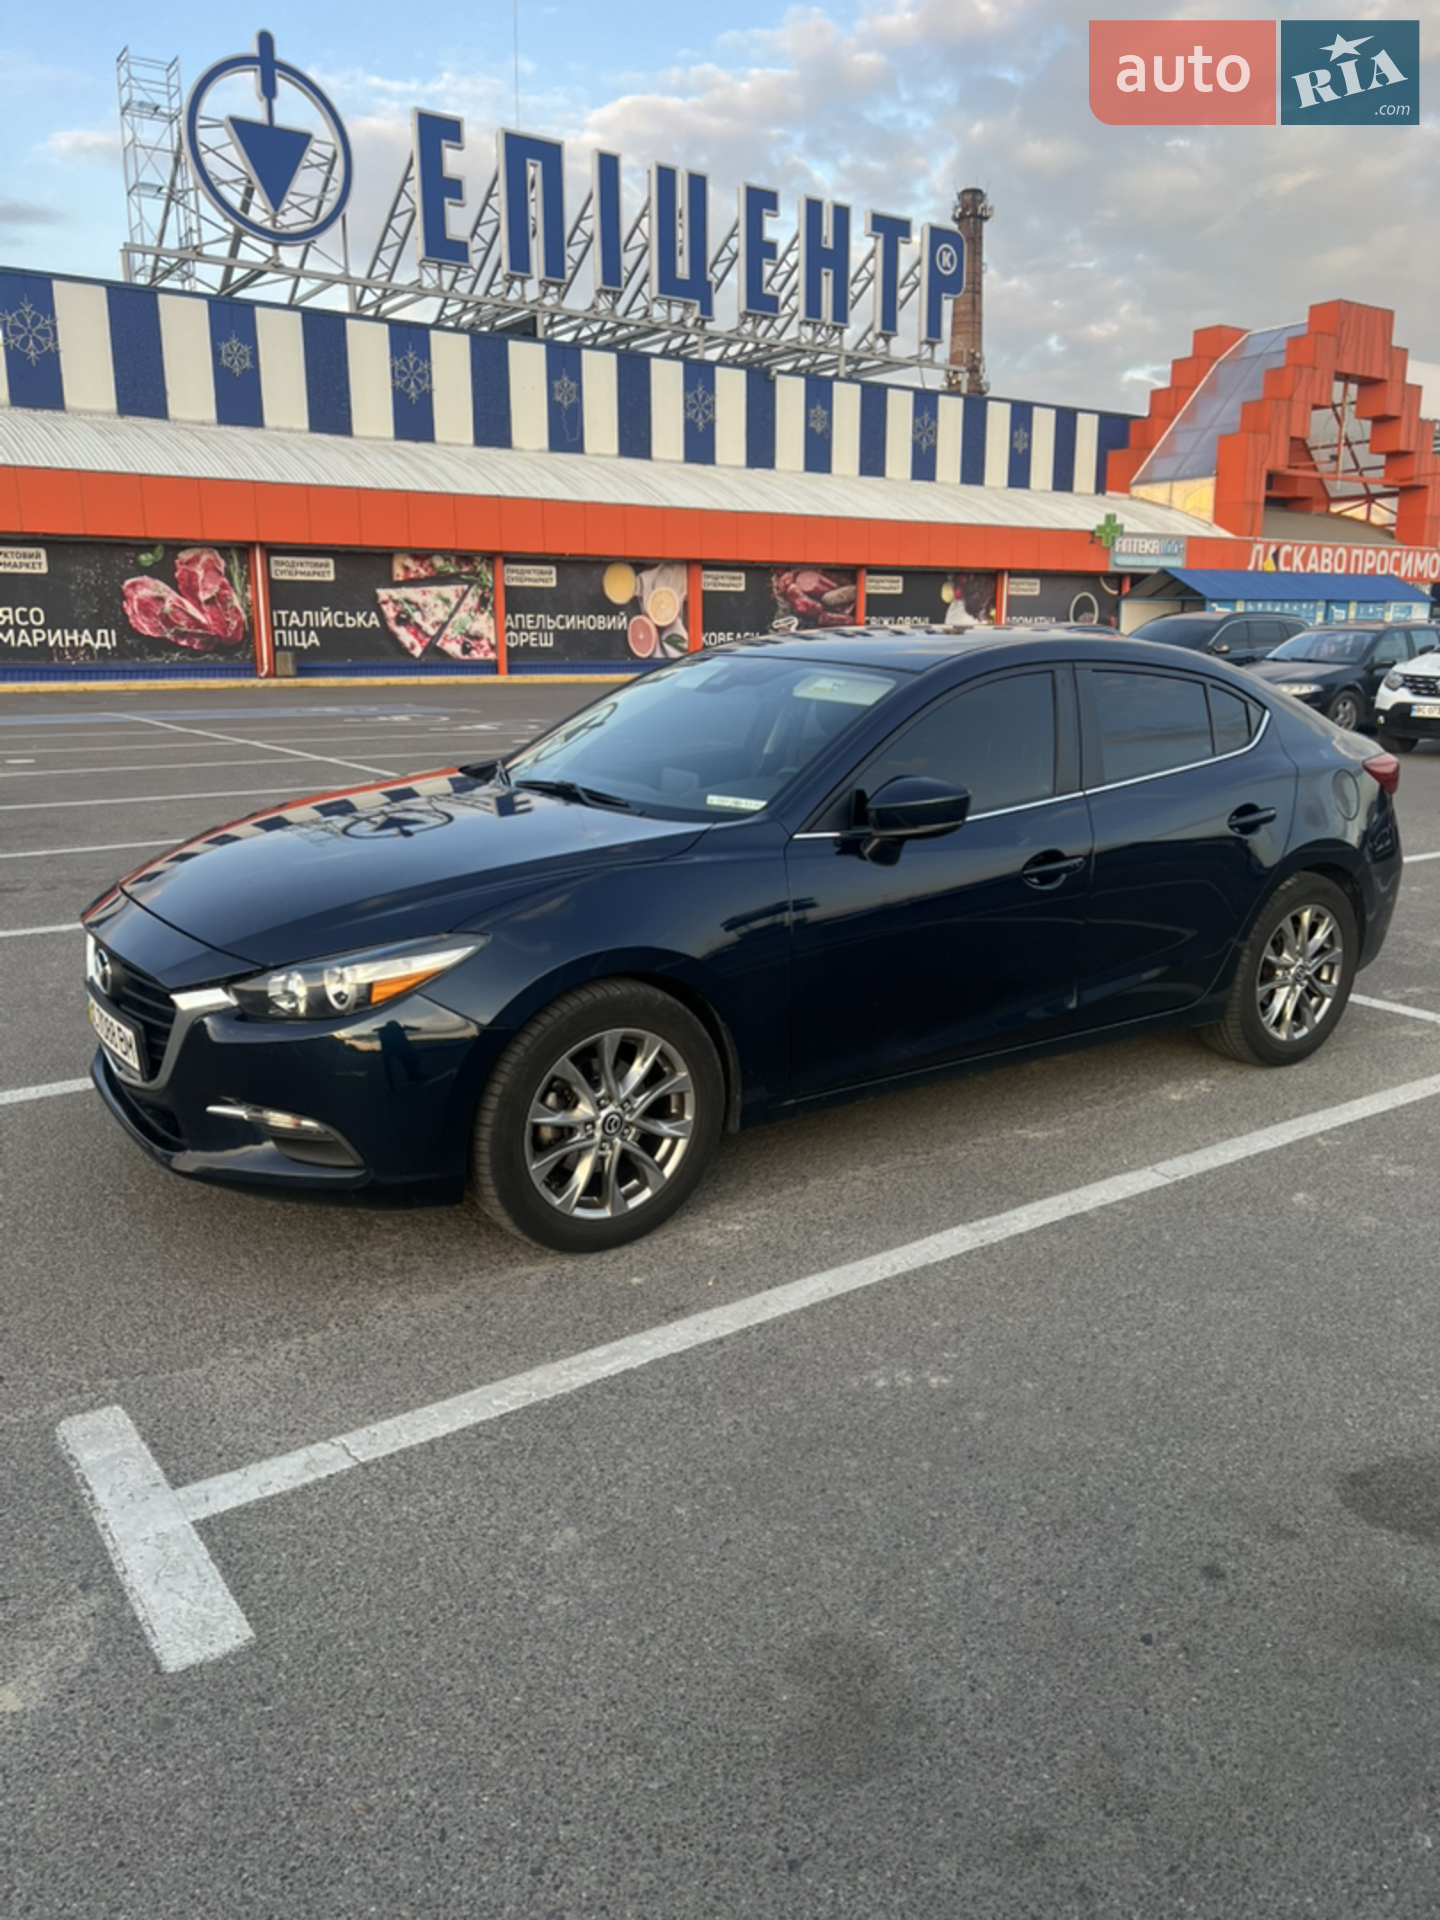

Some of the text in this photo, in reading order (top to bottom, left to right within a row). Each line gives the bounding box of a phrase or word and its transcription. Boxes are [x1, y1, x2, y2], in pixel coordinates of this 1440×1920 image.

[412, 107, 966, 343] ЕПІЦЕНТР
[1115, 537, 1160, 554] АПТЕКА
[0, 550, 42, 560] КТОВИЙ
[274, 559, 331, 568] ПРОДУКТОВИЙ
[1351, 549, 1440, 579] ПРОСИМО
[0, 561, 43, 570] МАРКЕТ
[274, 569, 331, 578] СУПЕРМАРКЕТ
[272, 606, 381, 629] ІТАЛІЙСЬКА
[505, 611, 628, 631] АПЕЛЬСИНОВИЙ
[0, 629, 117, 650] МАРИНАДІ
[274, 630, 321, 650] ПІЦА
[505, 631, 554, 648] ФРЕШ
